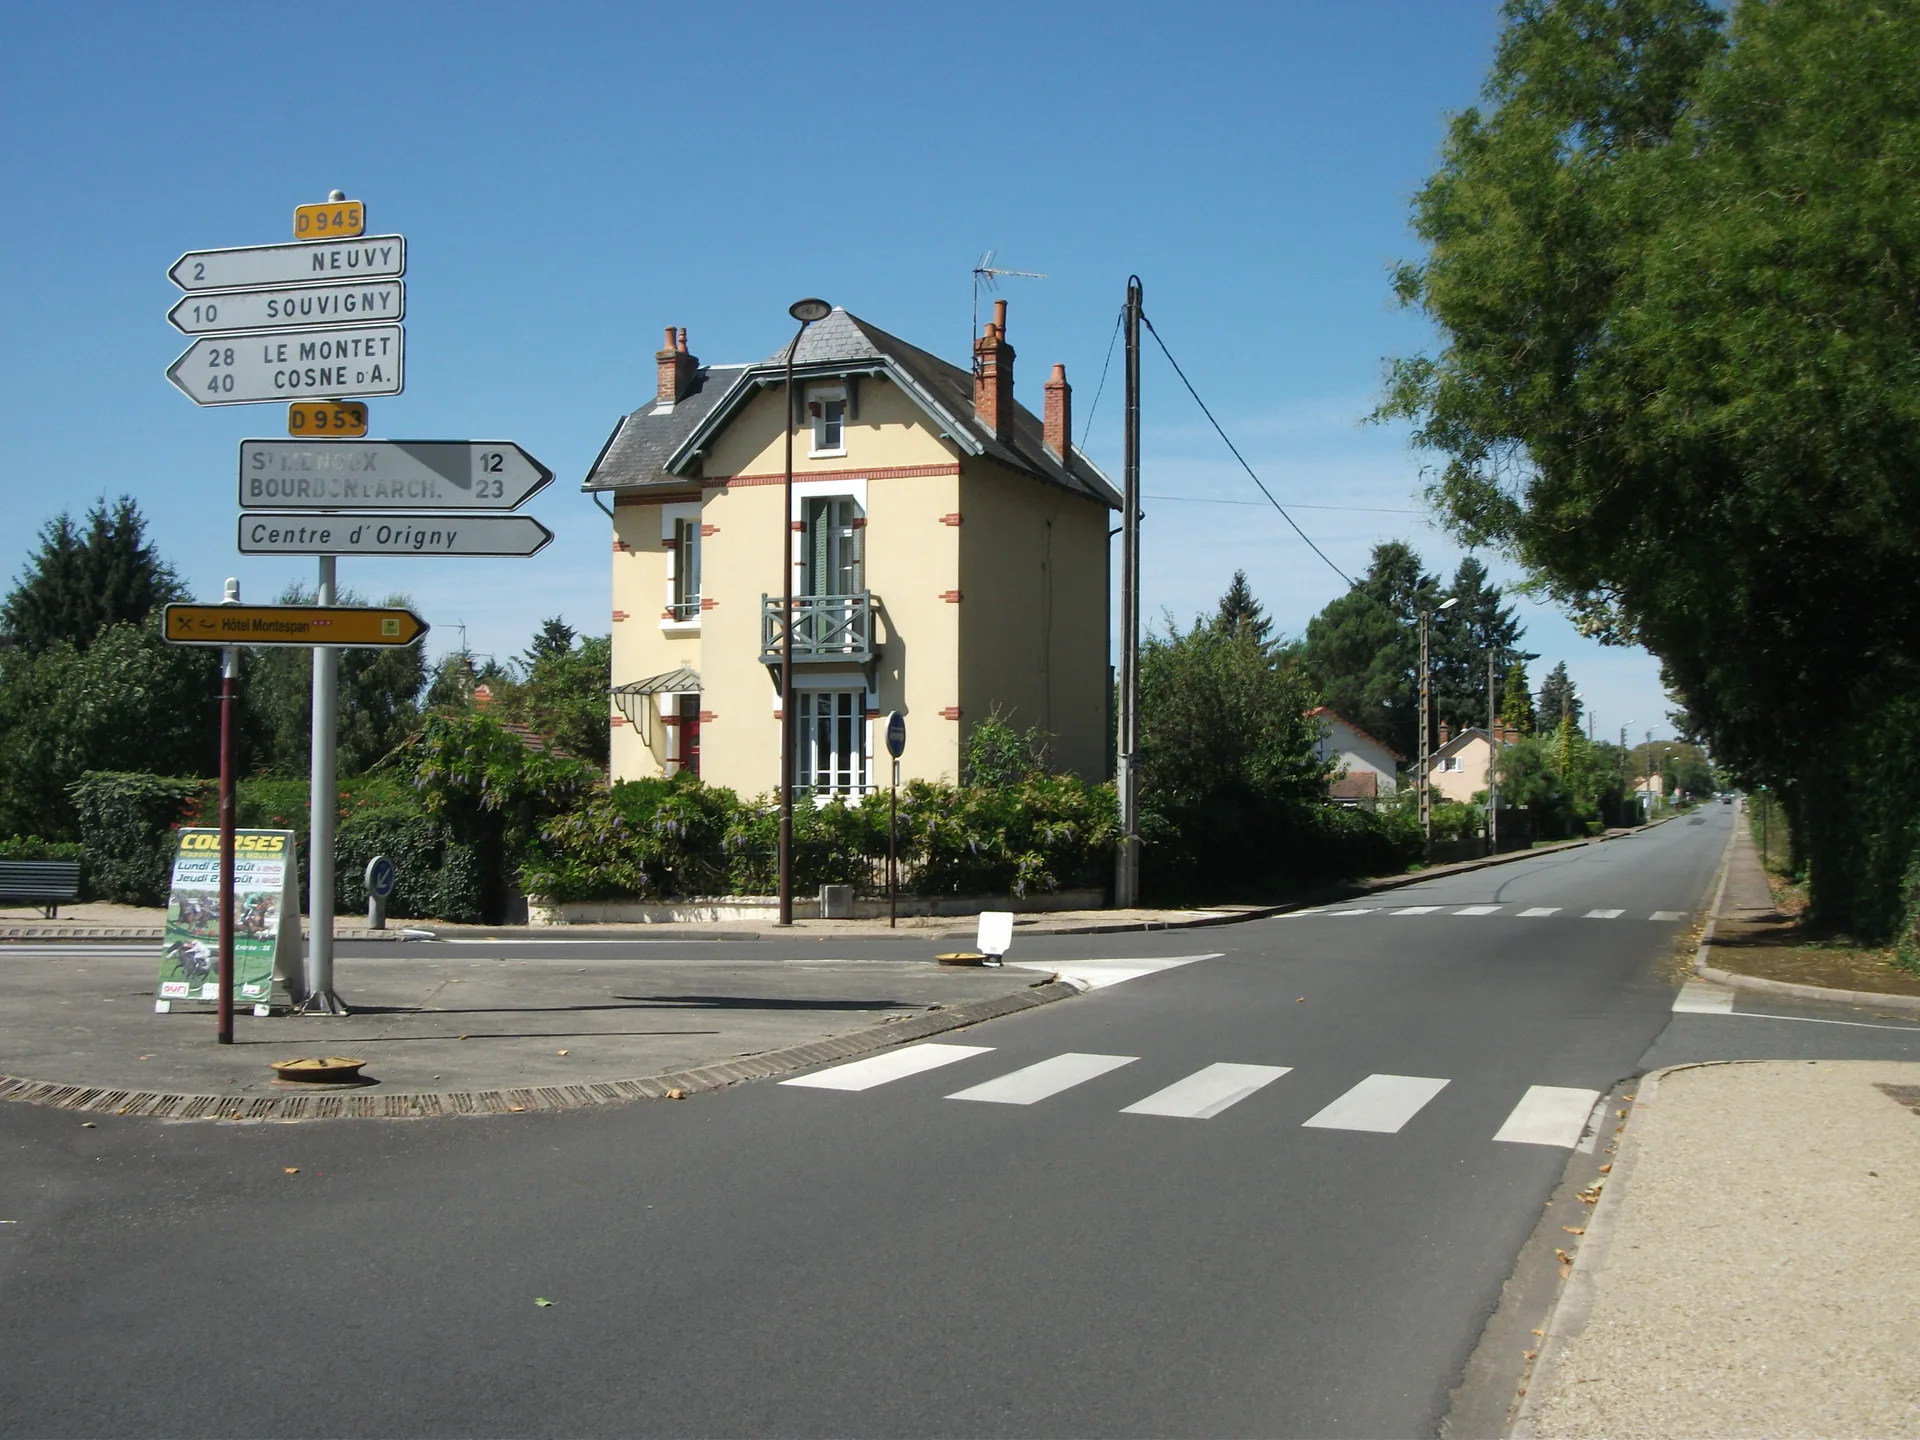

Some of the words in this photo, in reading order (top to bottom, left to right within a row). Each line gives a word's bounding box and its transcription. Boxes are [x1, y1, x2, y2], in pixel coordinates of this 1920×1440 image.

[193, 262, 205, 281] 2
[312, 246, 392, 272] NEUVY
[193, 304, 217, 323] 10
[267, 291, 392, 318] SOUVIGNY
[208, 348, 235, 368] 28
[264, 344, 287, 364] LE
[299, 337, 391, 362] MONTET
[207, 373, 235, 393] 40
[274, 366, 347, 390] COSNE
[480, 453, 504, 473] 12
[475, 480, 504, 499] 23
[252, 523, 331, 544] Centre
[350, 525, 458, 550] d'Origny
[222, 617, 249, 631] Hôtel
[252, 618, 310, 635] Montespan
[179, 851, 221, 859] Hippodro
[177, 861, 210, 871] Lundi
[235, 862, 255, 871] oût
[176, 873, 208, 882] Jeudi
[234, 874, 253, 883] oût
